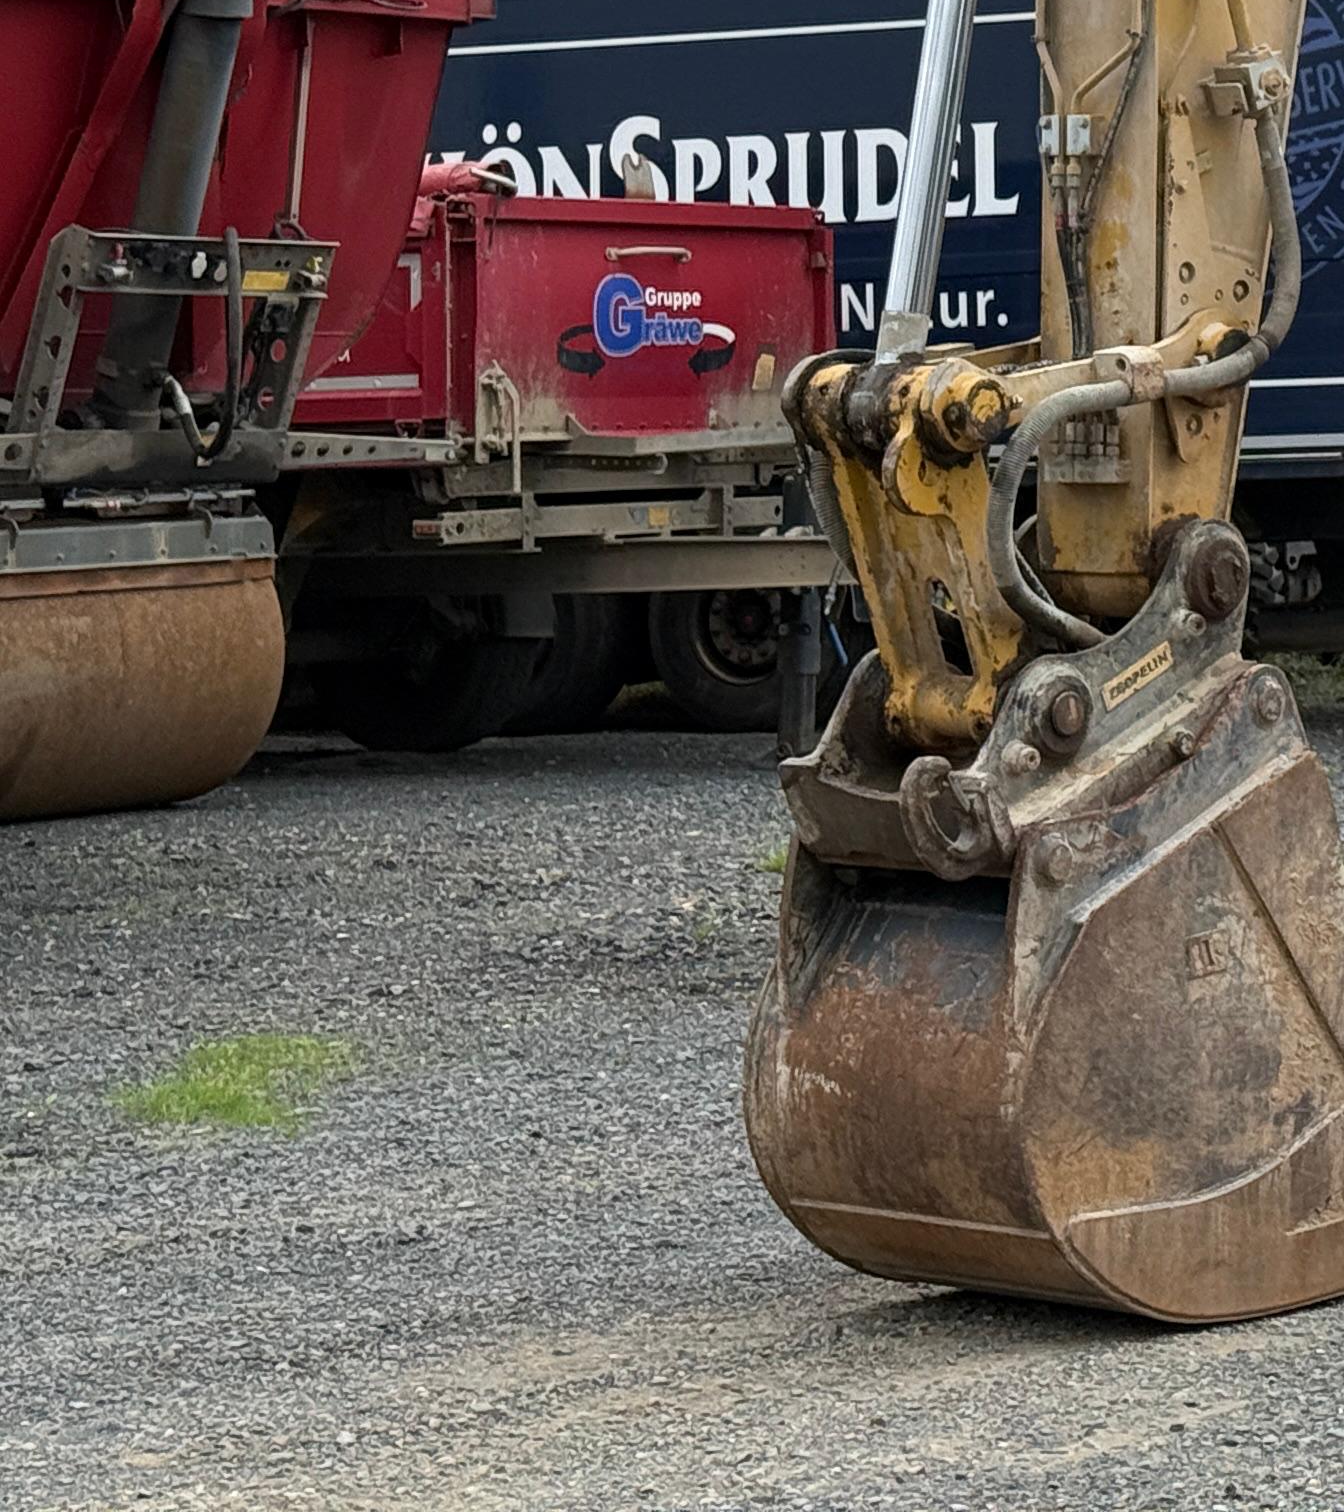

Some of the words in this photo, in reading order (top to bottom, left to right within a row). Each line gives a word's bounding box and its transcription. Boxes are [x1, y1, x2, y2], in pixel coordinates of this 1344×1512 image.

[593, 273, 704, 357] Gräwe
[645, 287, 702, 312] Gruppe
[840, 282, 1009, 333] Nur.
